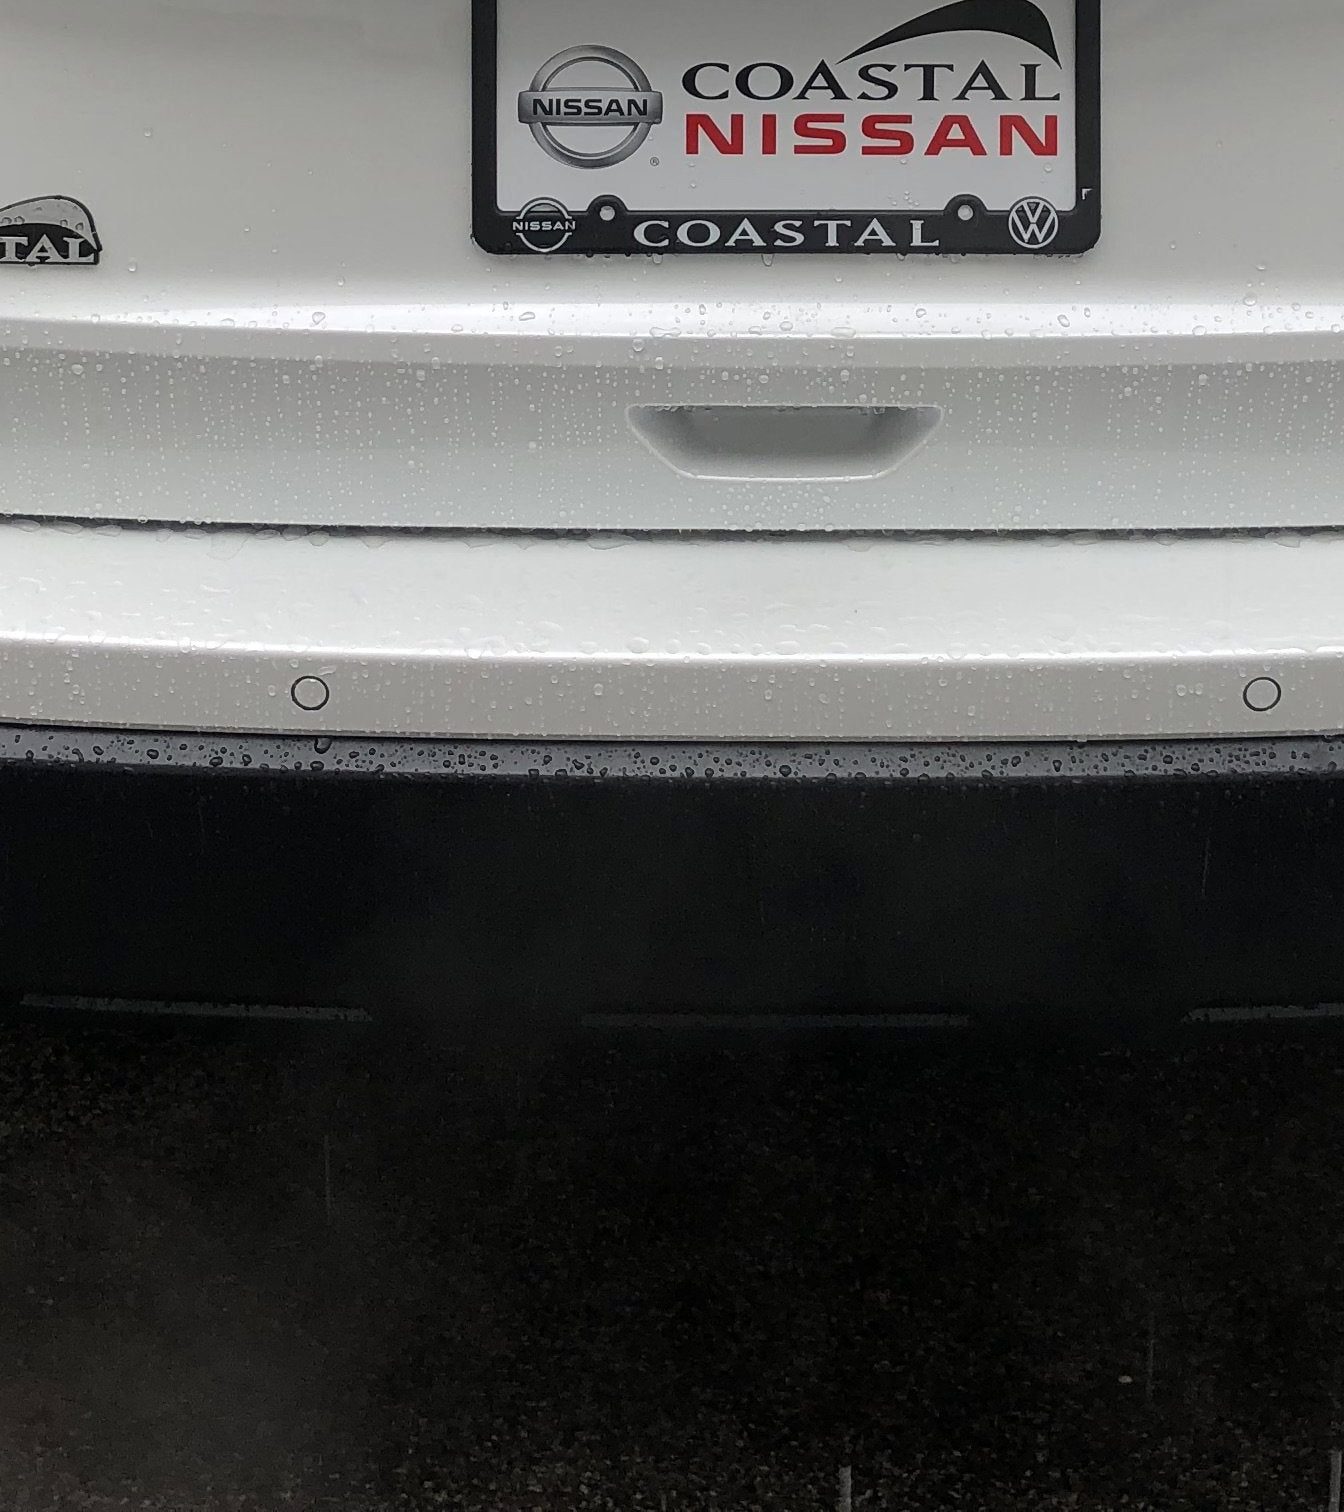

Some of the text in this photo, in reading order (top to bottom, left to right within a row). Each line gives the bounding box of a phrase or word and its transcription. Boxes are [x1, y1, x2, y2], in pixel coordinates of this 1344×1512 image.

[681, 59, 1061, 102] COASTAL
[531, 97, 649, 117] NISSAN
[685, 113, 1059, 157] NISSAN
[512, 220, 576, 231] NISSAN
[633, 217, 940, 248] COASTAL
